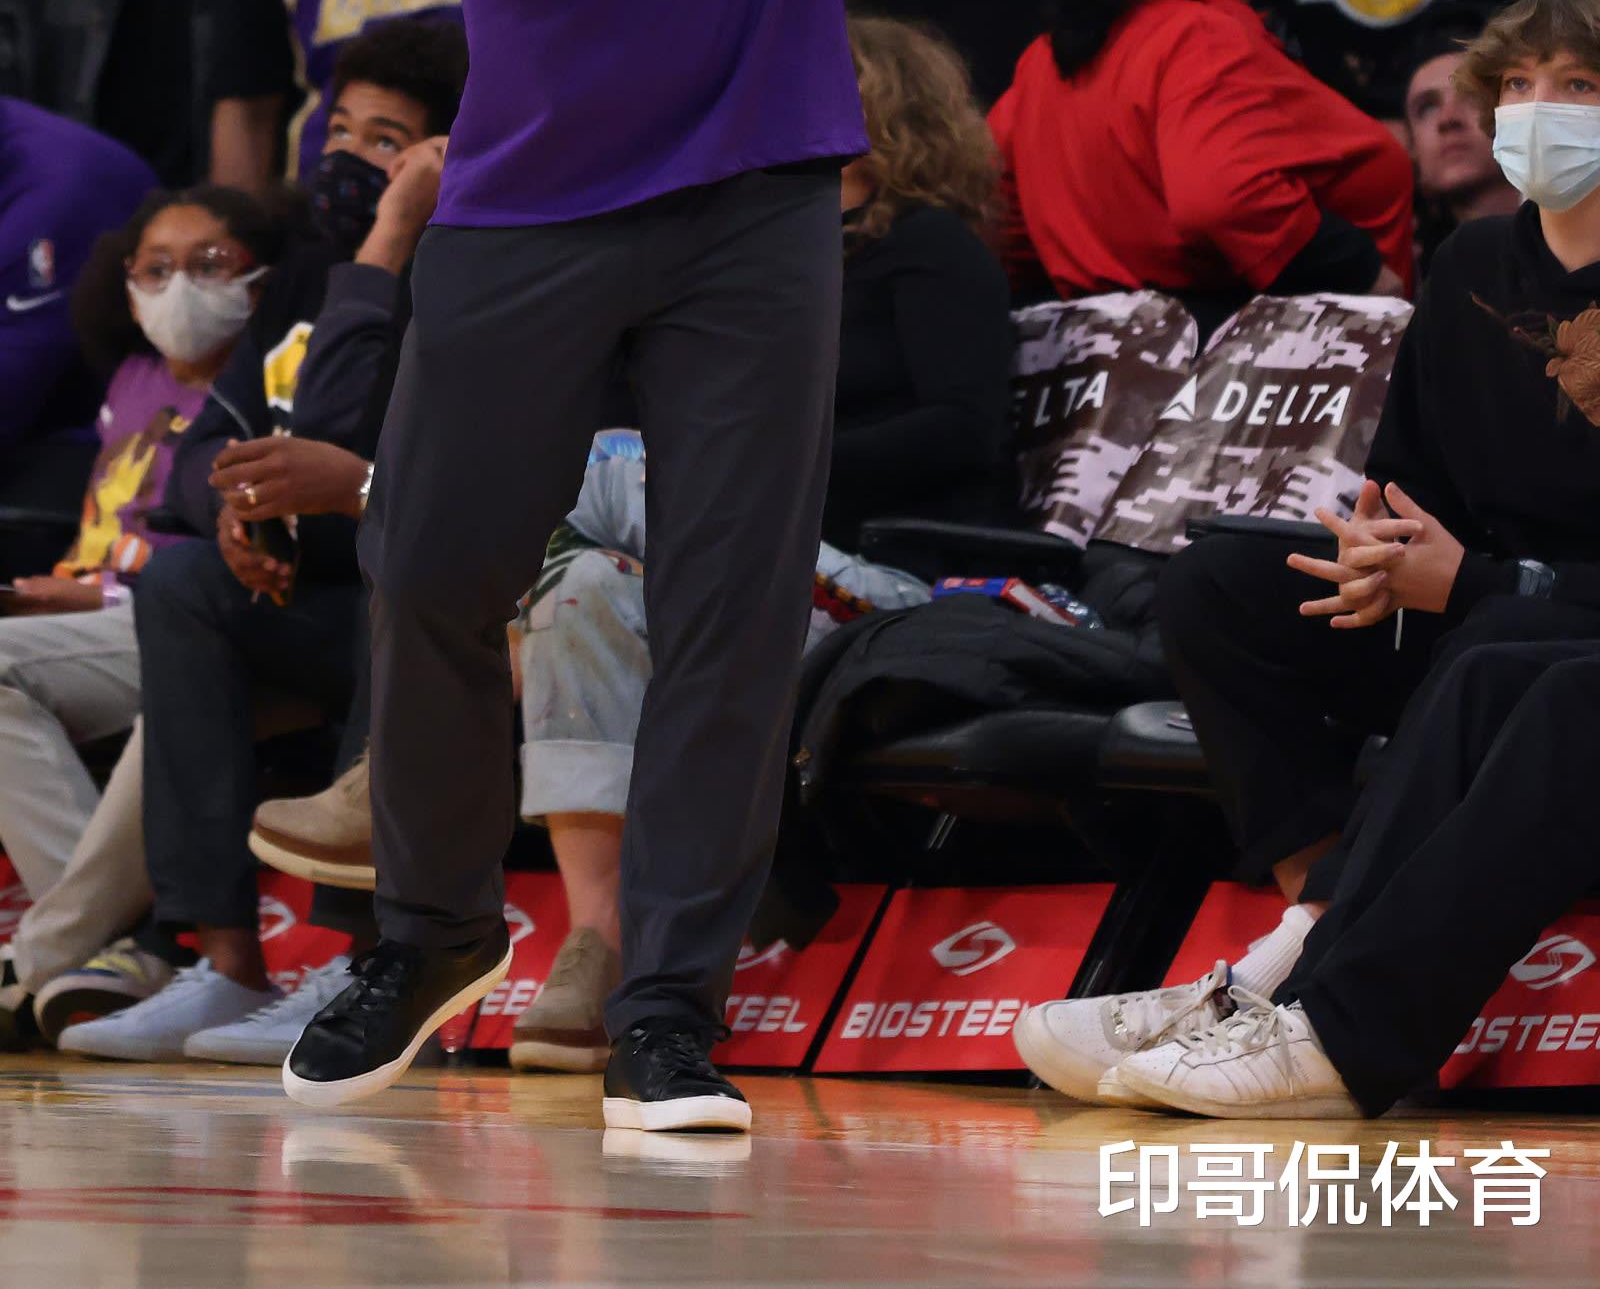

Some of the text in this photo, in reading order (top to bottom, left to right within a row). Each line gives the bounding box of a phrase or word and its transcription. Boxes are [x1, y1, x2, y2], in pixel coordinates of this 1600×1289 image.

[1211, 381, 1352, 427] DELTA
[840, 998, 1032, 1039] BIOSTEE
[1453, 1013, 1600, 1055] OSTEE
